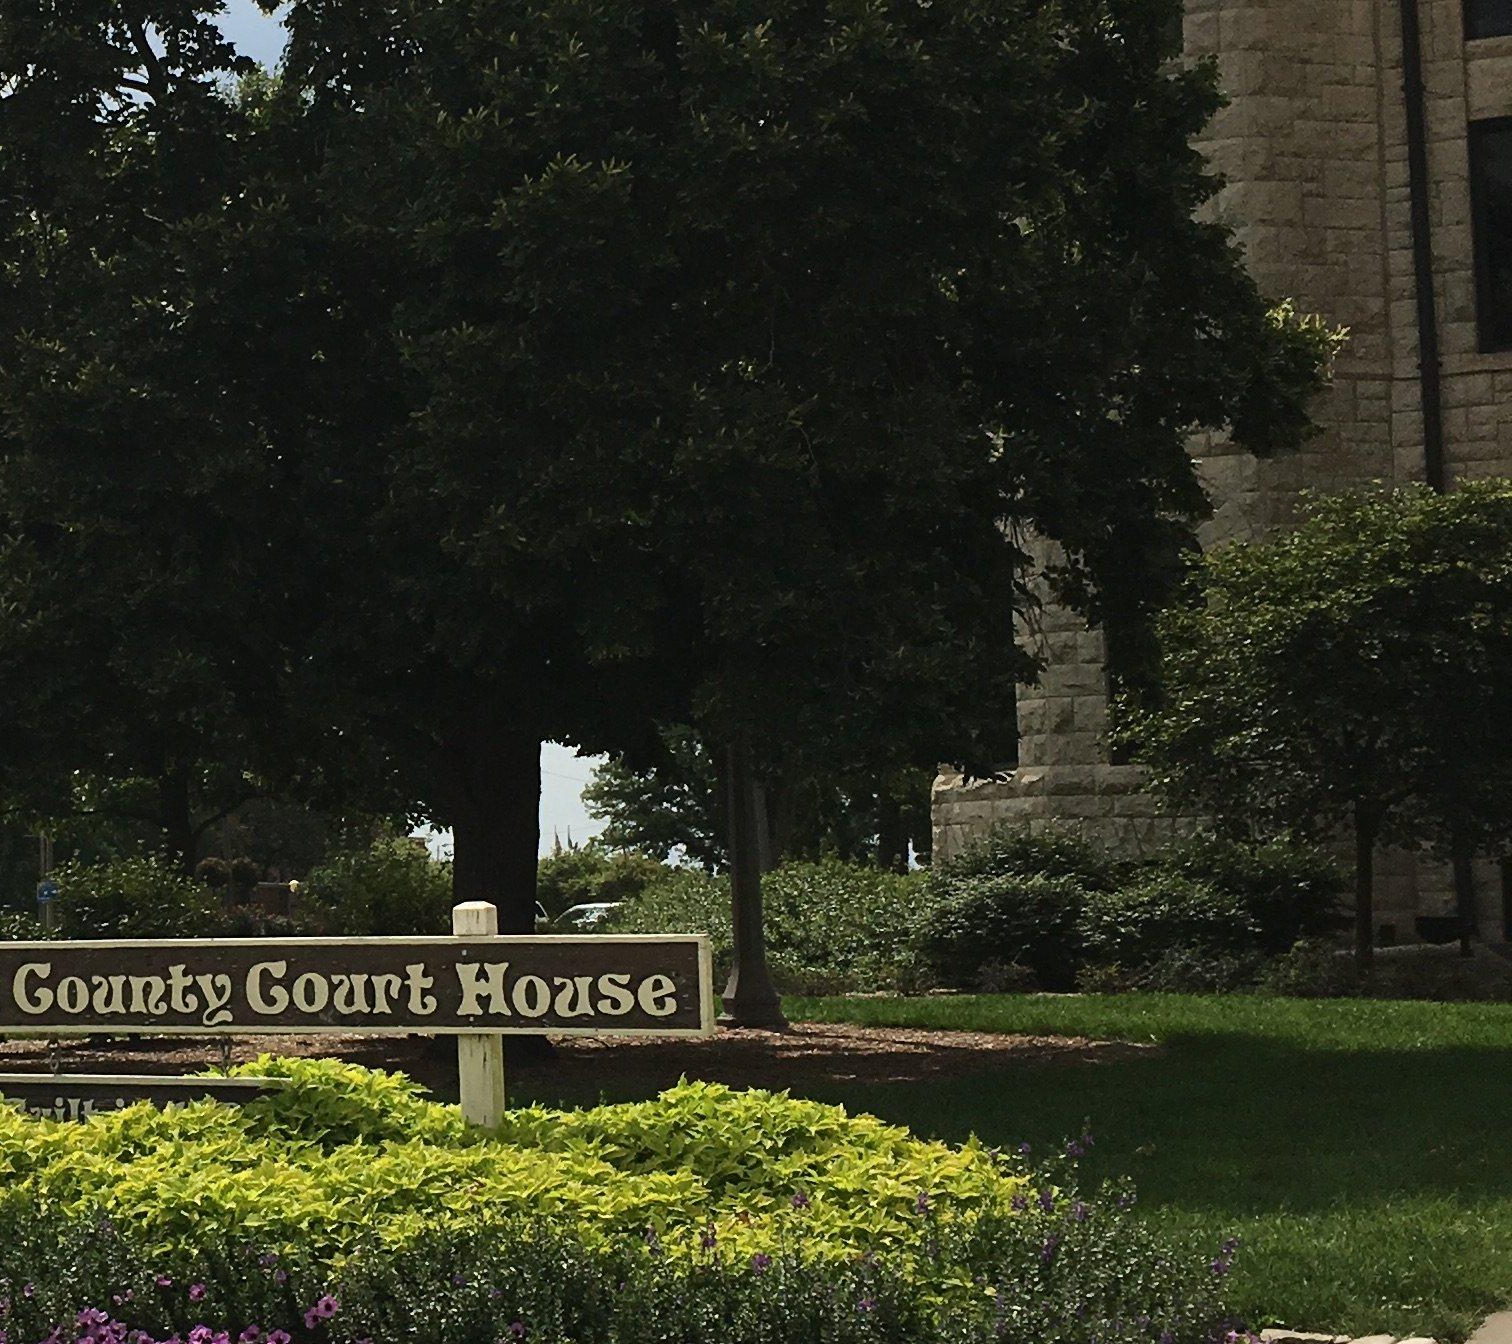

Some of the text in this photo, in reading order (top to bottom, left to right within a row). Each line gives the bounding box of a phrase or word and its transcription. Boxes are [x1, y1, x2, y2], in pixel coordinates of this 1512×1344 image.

[12, 961, 233, 1027] County
[245, 960, 438, 1016] Court
[455, 961, 678, 1018] House
